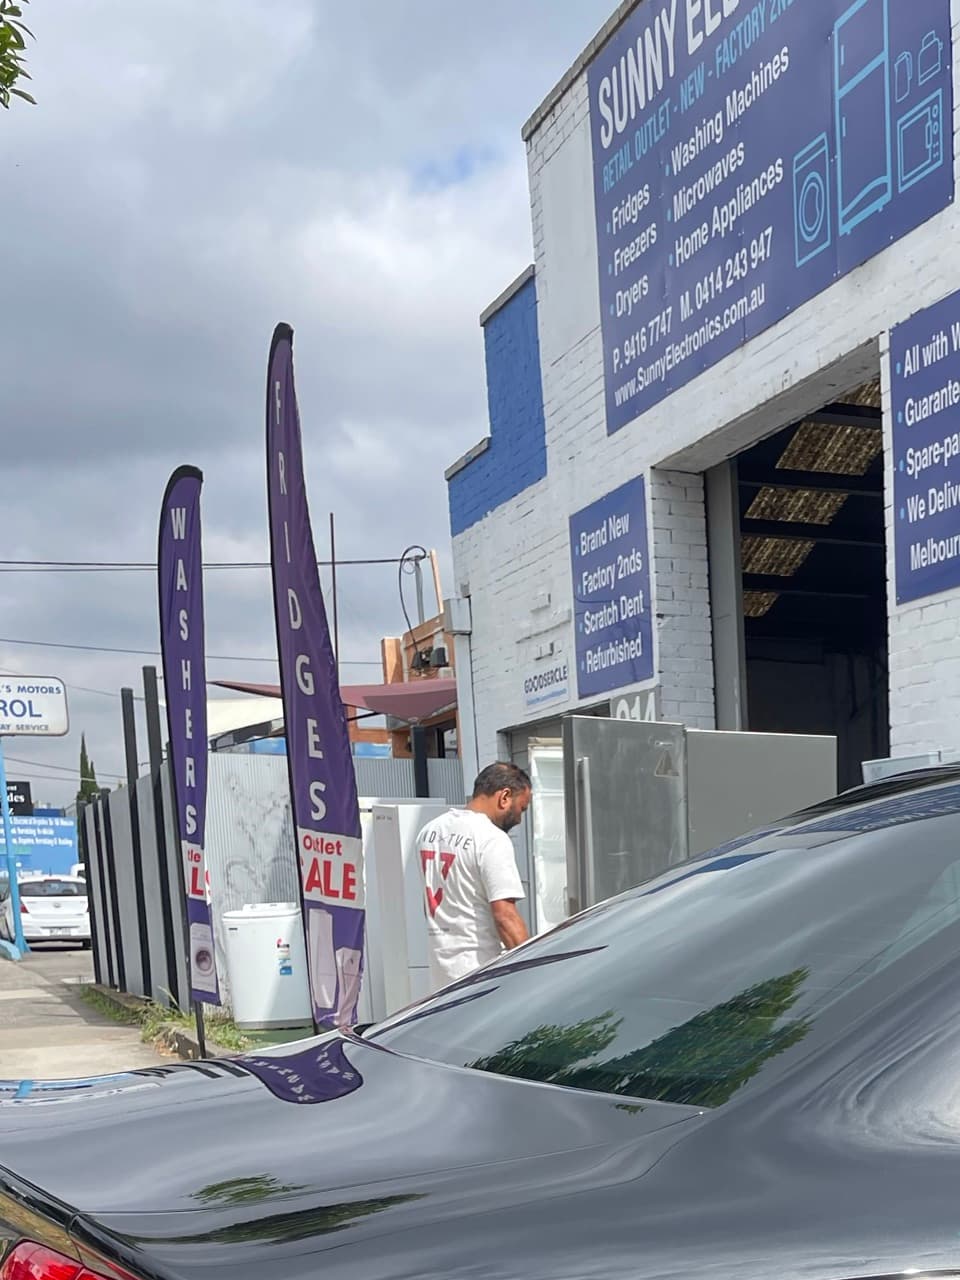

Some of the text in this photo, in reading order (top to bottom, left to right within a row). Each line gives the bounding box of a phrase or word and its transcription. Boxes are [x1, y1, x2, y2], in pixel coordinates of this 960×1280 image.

[599, 0, 676, 148] SUNNY
[603, 142, 633, 194] RETAIL
[634, 98, 670, 160] OUTLET
[680, 62, 704, 114] NEW
[715, 1, 766, 79] FACTORY
[671, 46, 789, 176] Washing Machines
[673, 141, 745, 223] Microwaves
[612, 183, 650, 235] Fridges
[675, 158, 783, 268] Home Appliances
[614, 222, 657, 276] Freezers
[613, 225, 773, 374] P. 9416 7747 M. 0414 243 947
[616, 275, 649, 317] Dryers
[614, 283, 765, 407] www.SunnyElectronics.com.au
[904, 348, 920, 378] All
[922, 333, 949, 366] with
[580, 512, 630, 556] Brand New
[906, 497, 925, 523] We
[582, 548, 642, 596] Factory 2nds
[274, 380, 327, 822] FRIDGES
[584, 590, 644, 635] Scratch Dent
[171, 507, 198, 836] WASHERS
[586, 631, 642, 674] Refurbished
[17, 685, 61, 694] MOTORS
[301, 856, 356, 901] ALE
